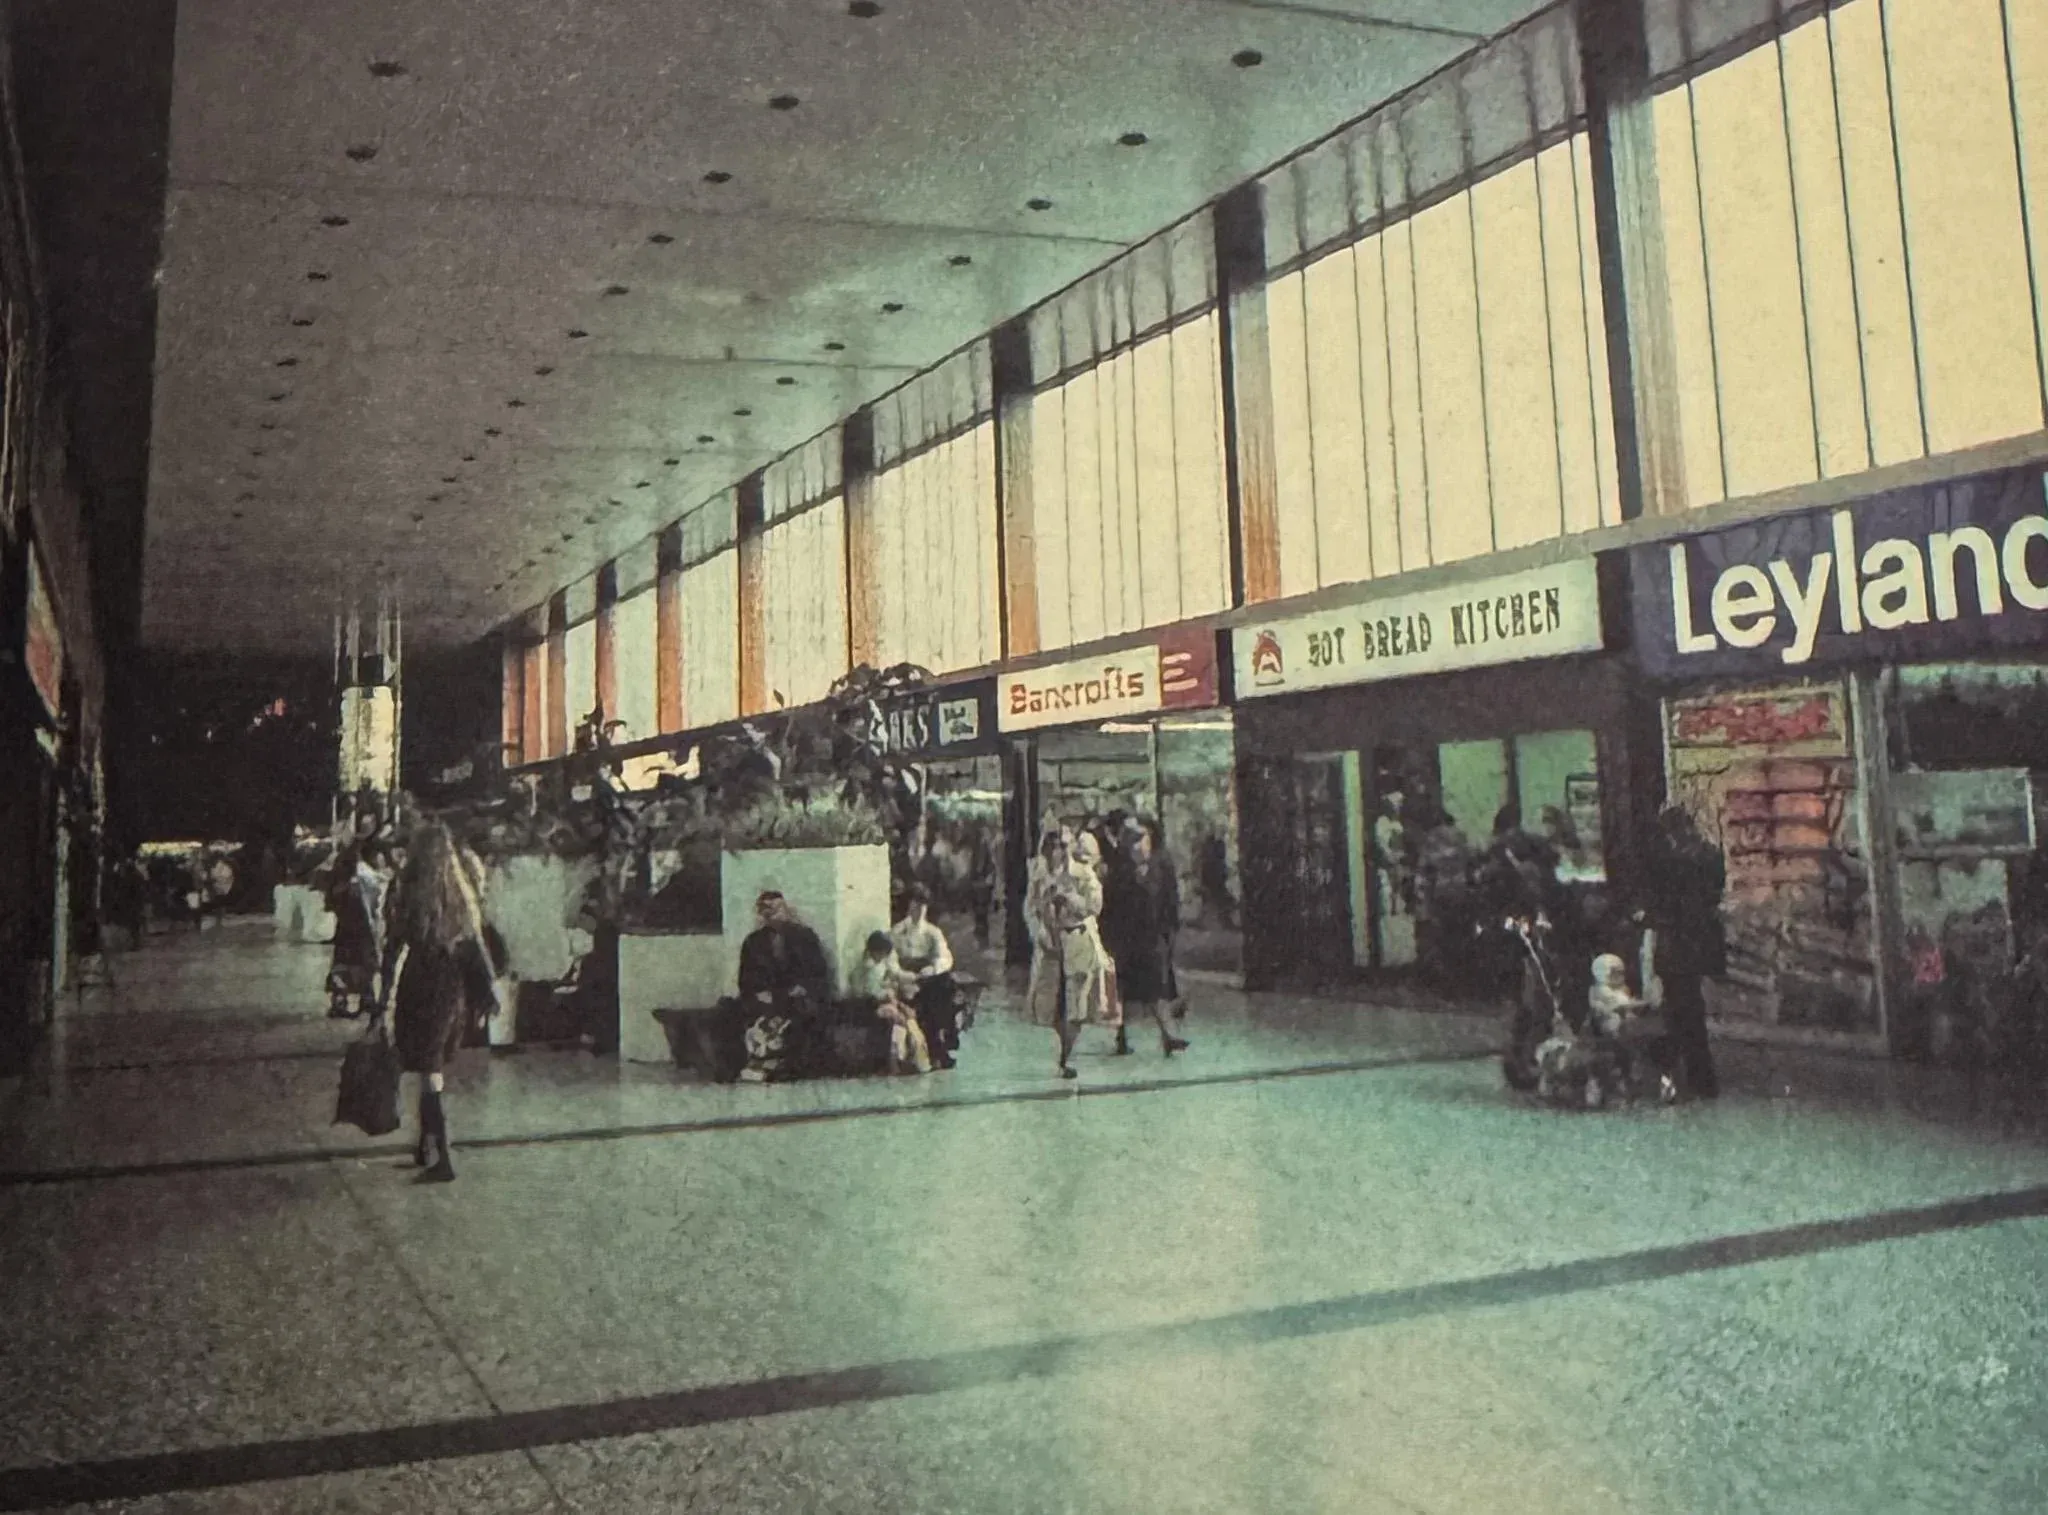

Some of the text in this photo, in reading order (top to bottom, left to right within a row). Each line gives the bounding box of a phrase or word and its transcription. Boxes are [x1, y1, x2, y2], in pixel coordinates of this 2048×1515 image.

[1362, 612, 1432, 660] BREAD
[1451, 587, 1561, 646] KITCHEN
[1010, 666, 1145, 714] Bancrofts
